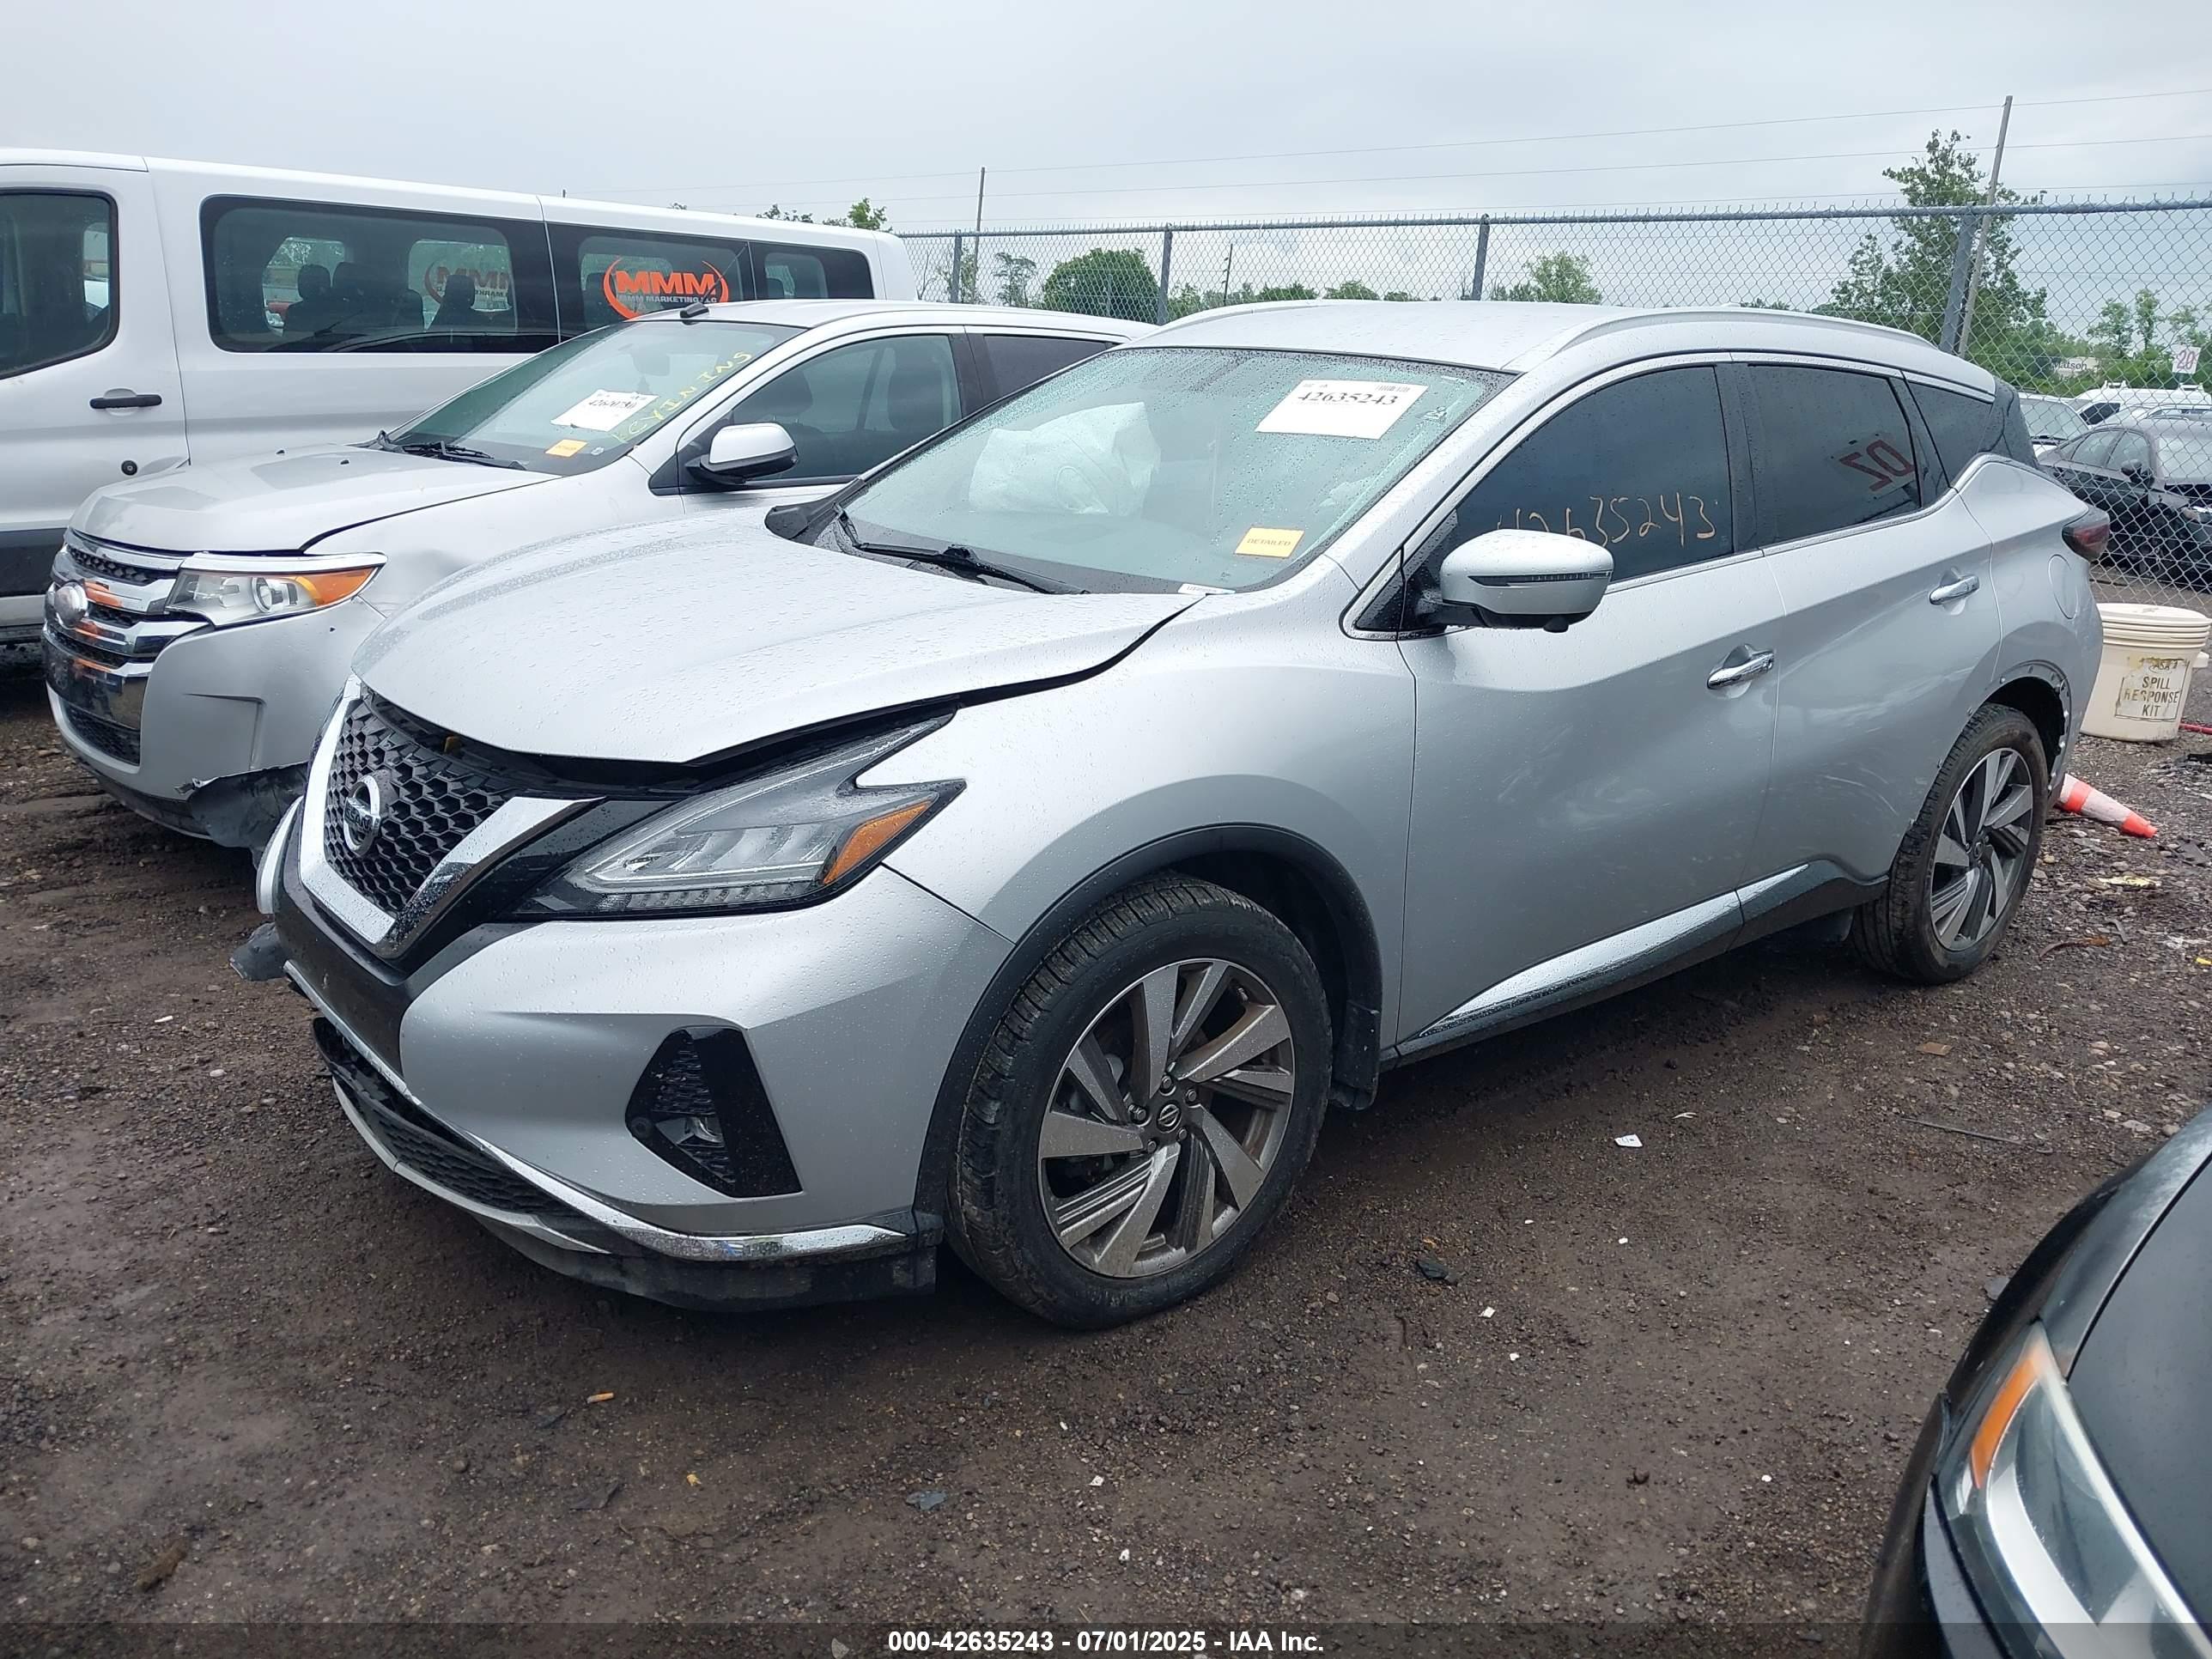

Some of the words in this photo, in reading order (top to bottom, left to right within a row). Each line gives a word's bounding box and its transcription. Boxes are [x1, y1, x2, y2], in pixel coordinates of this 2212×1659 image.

[615, 270, 716, 295] MMM
[646, 295, 699, 304] MARKETING
[1297, 392, 1399, 405] 42635243
[2142, 676, 2171, 690] SPILL
[2124, 688, 2180, 704] RESPONSE
[2142, 704, 2161, 717] KIT
